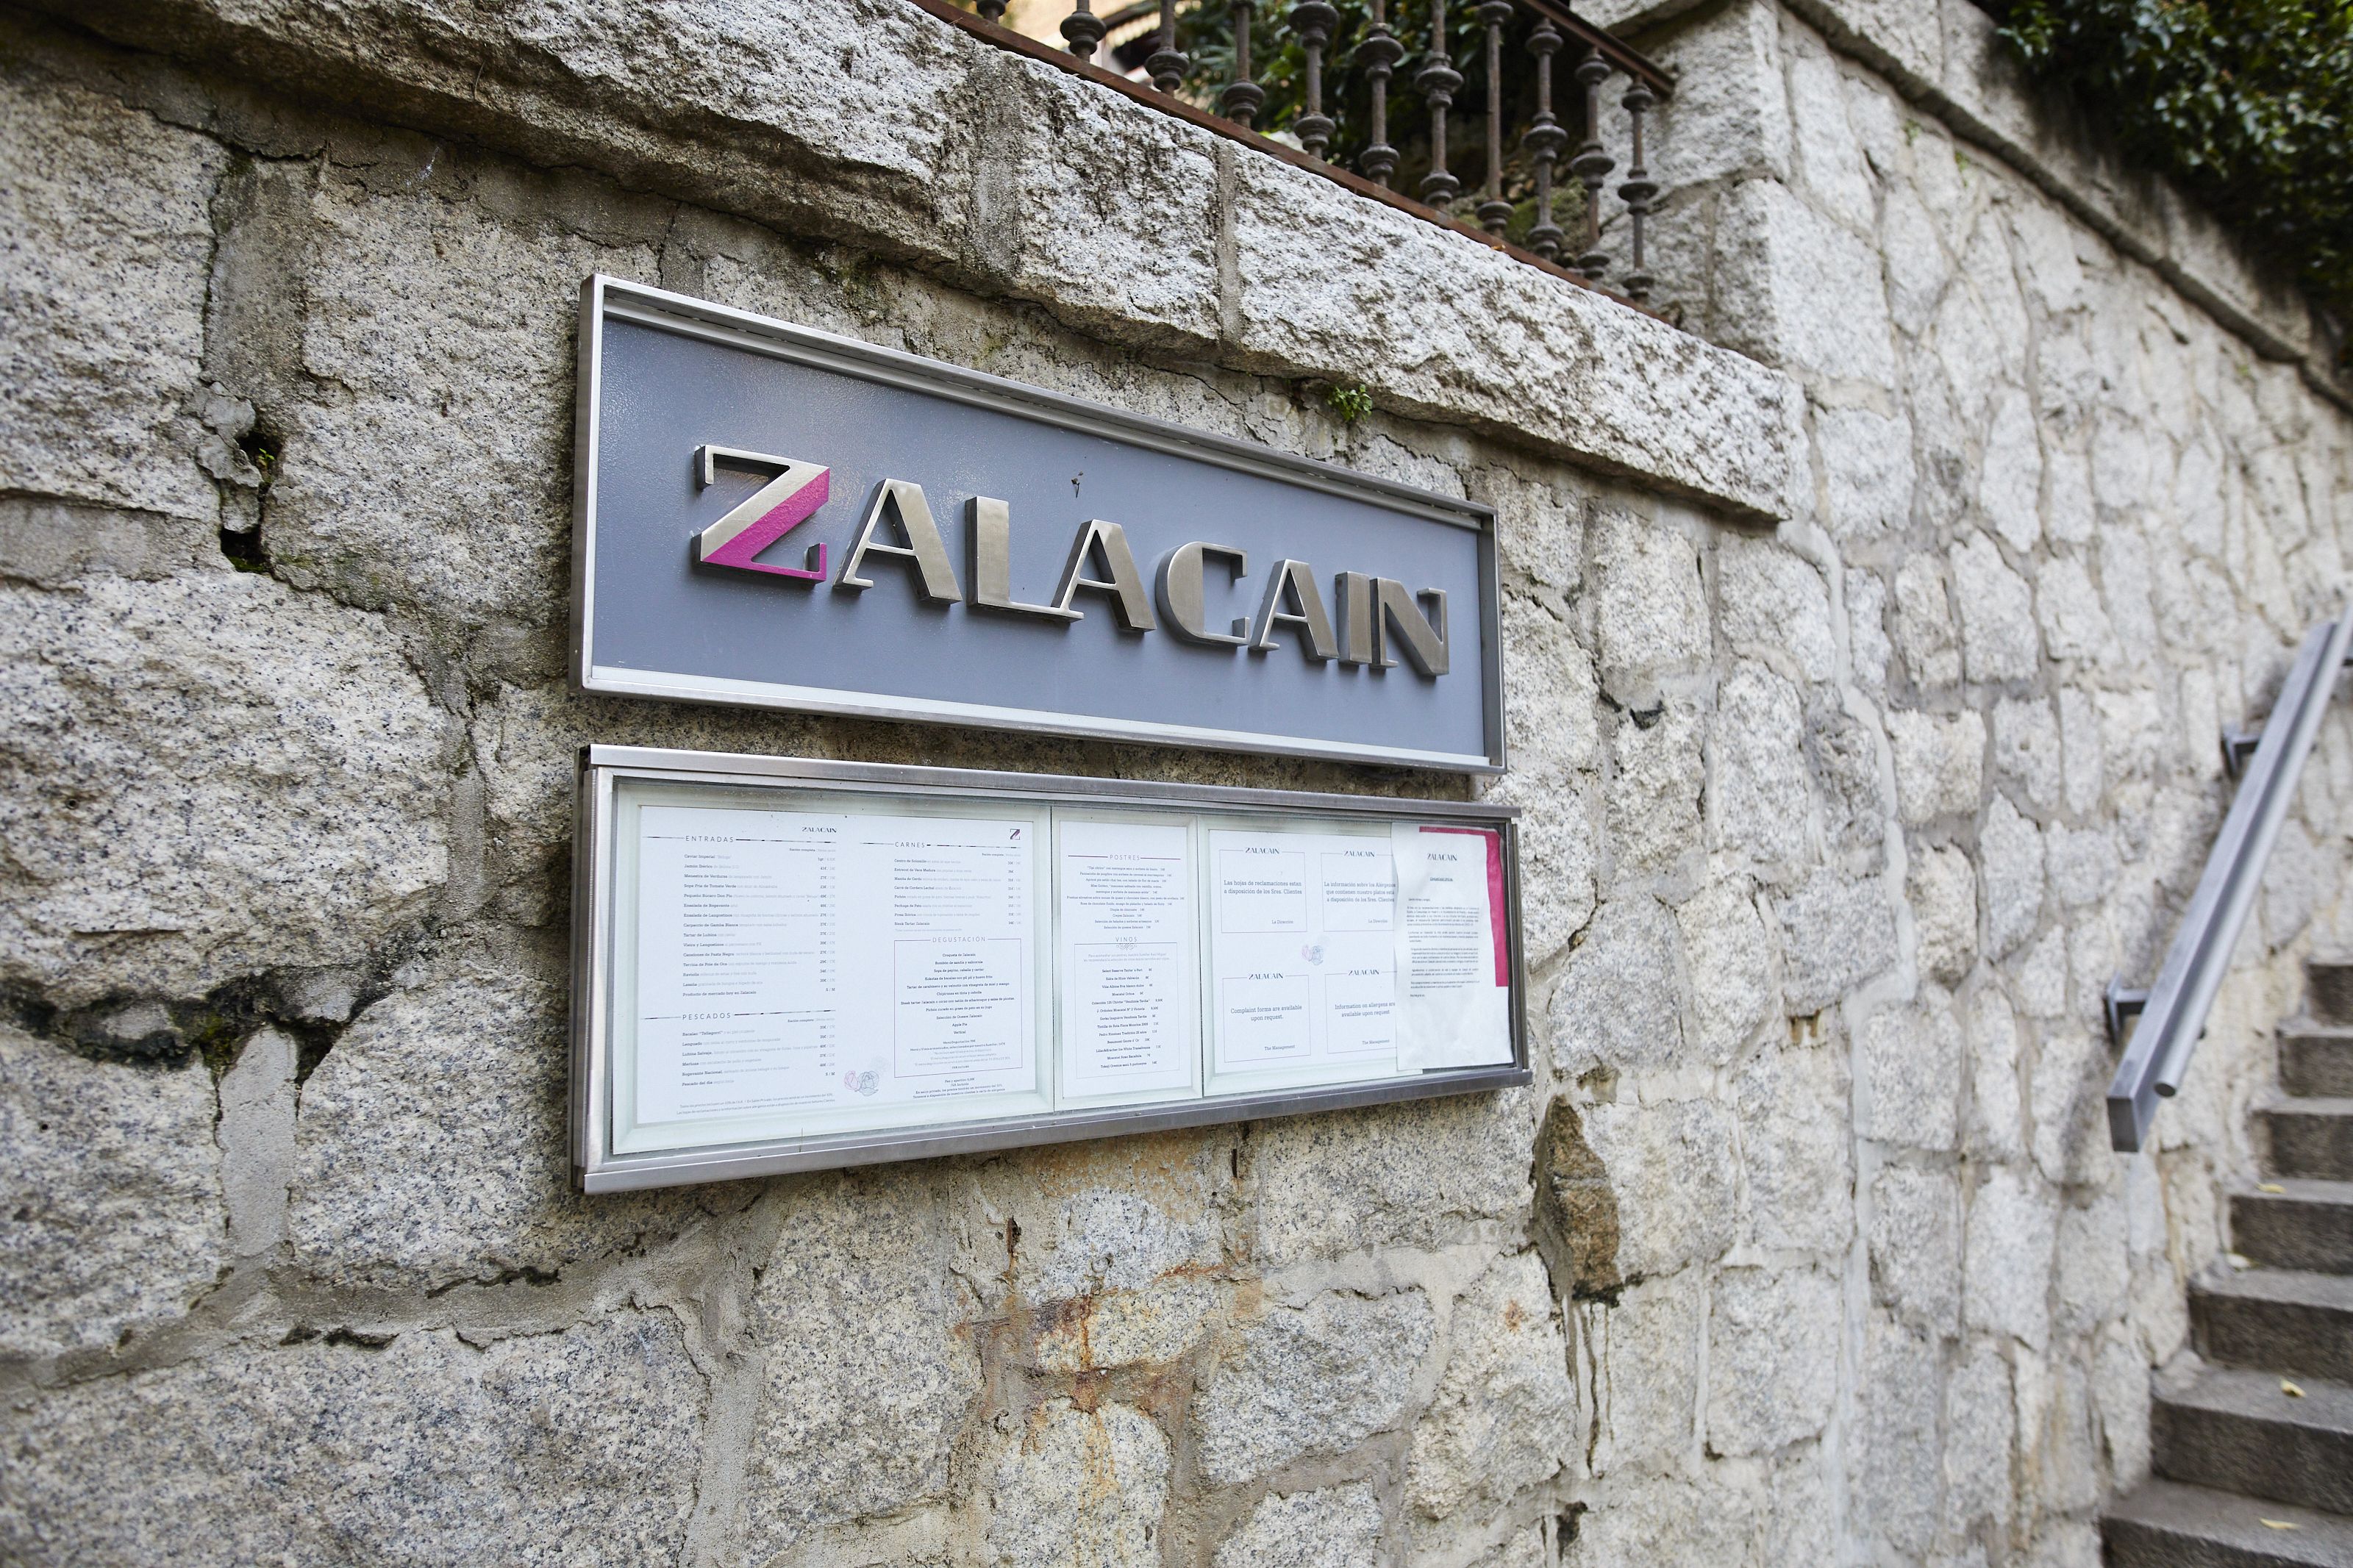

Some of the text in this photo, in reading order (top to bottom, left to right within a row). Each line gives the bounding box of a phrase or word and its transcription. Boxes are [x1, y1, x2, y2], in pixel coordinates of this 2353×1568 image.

[690, 444, 1450, 677] ZALACAIN
[1427, 853, 1457, 861] ZALACAIN
[682, 1012, 731, 1020] PESCADOS
